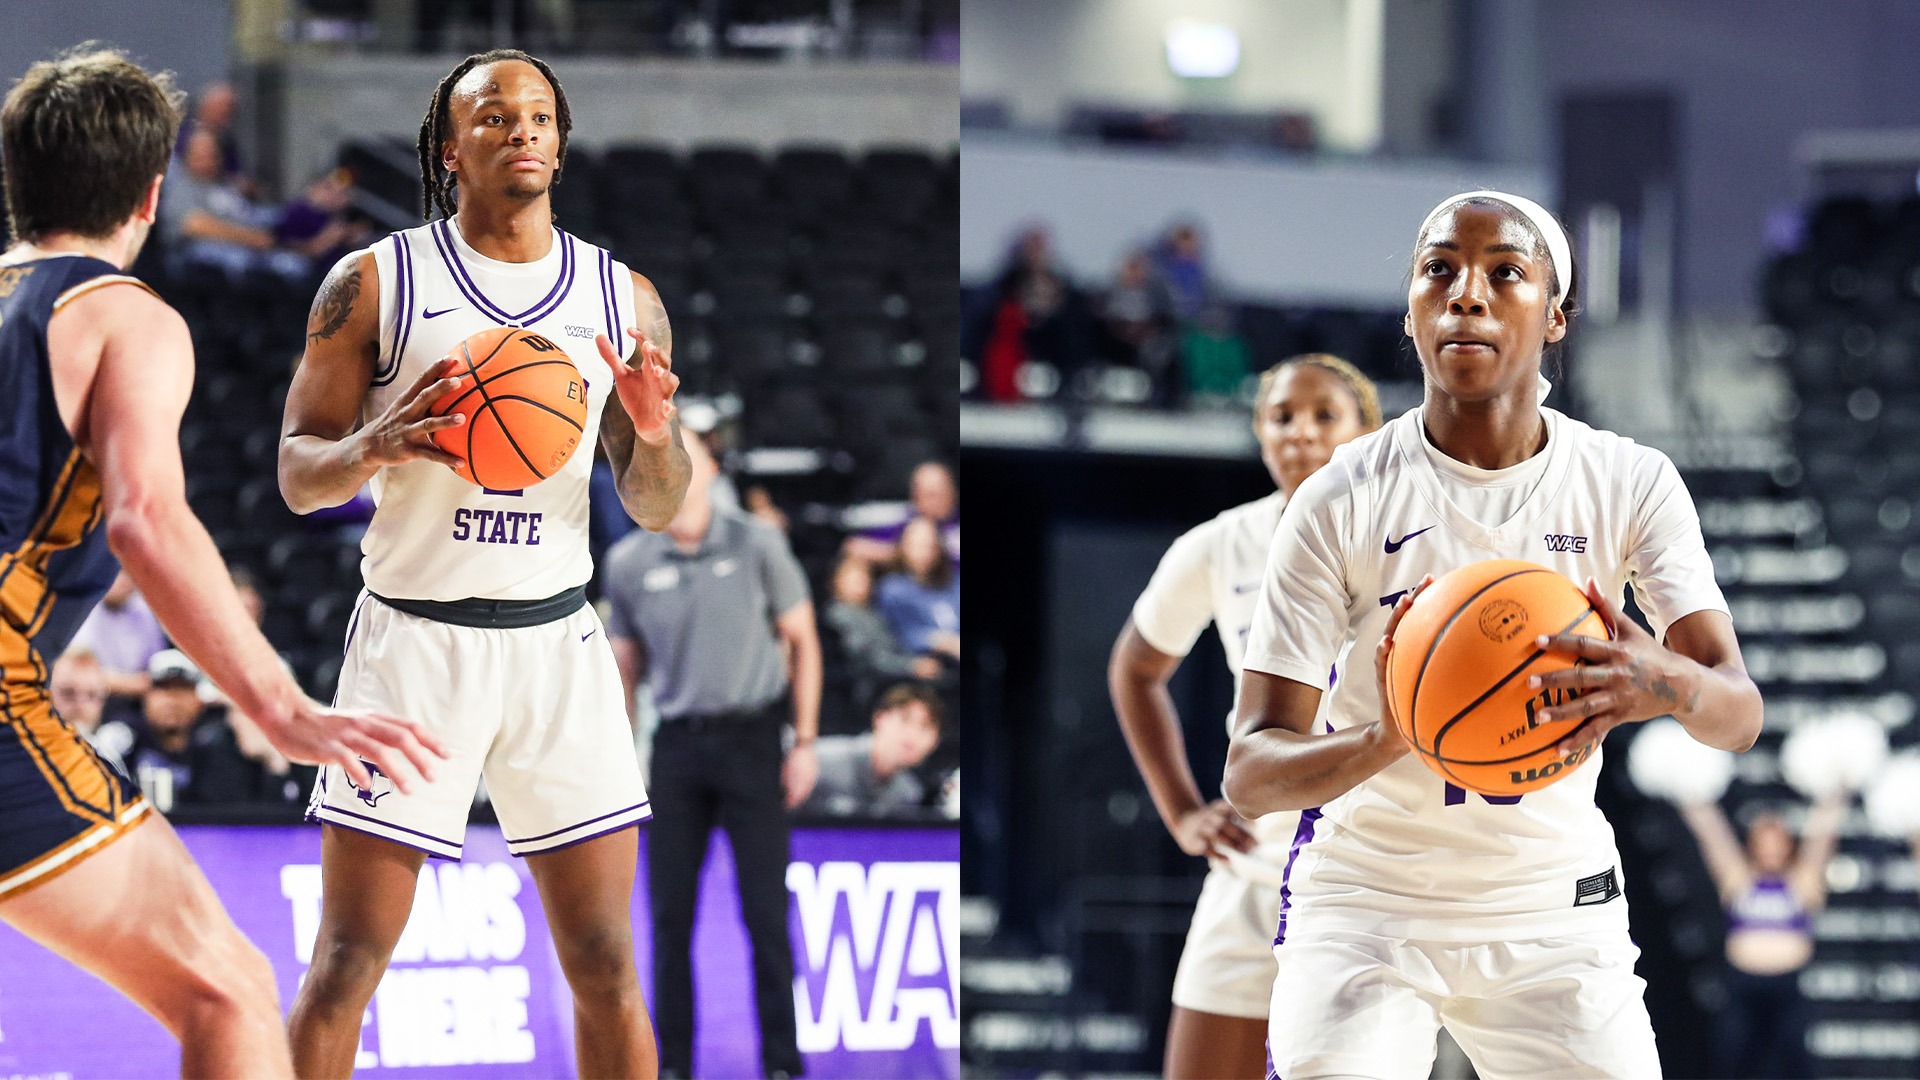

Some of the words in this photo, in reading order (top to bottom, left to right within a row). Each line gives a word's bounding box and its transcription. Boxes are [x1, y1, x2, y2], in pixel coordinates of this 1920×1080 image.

[565, 325, 594, 339] WAC
[453, 508, 542, 545] STATE
[1544, 534, 1587, 553] WAC
[280, 862, 526, 964] TANS
